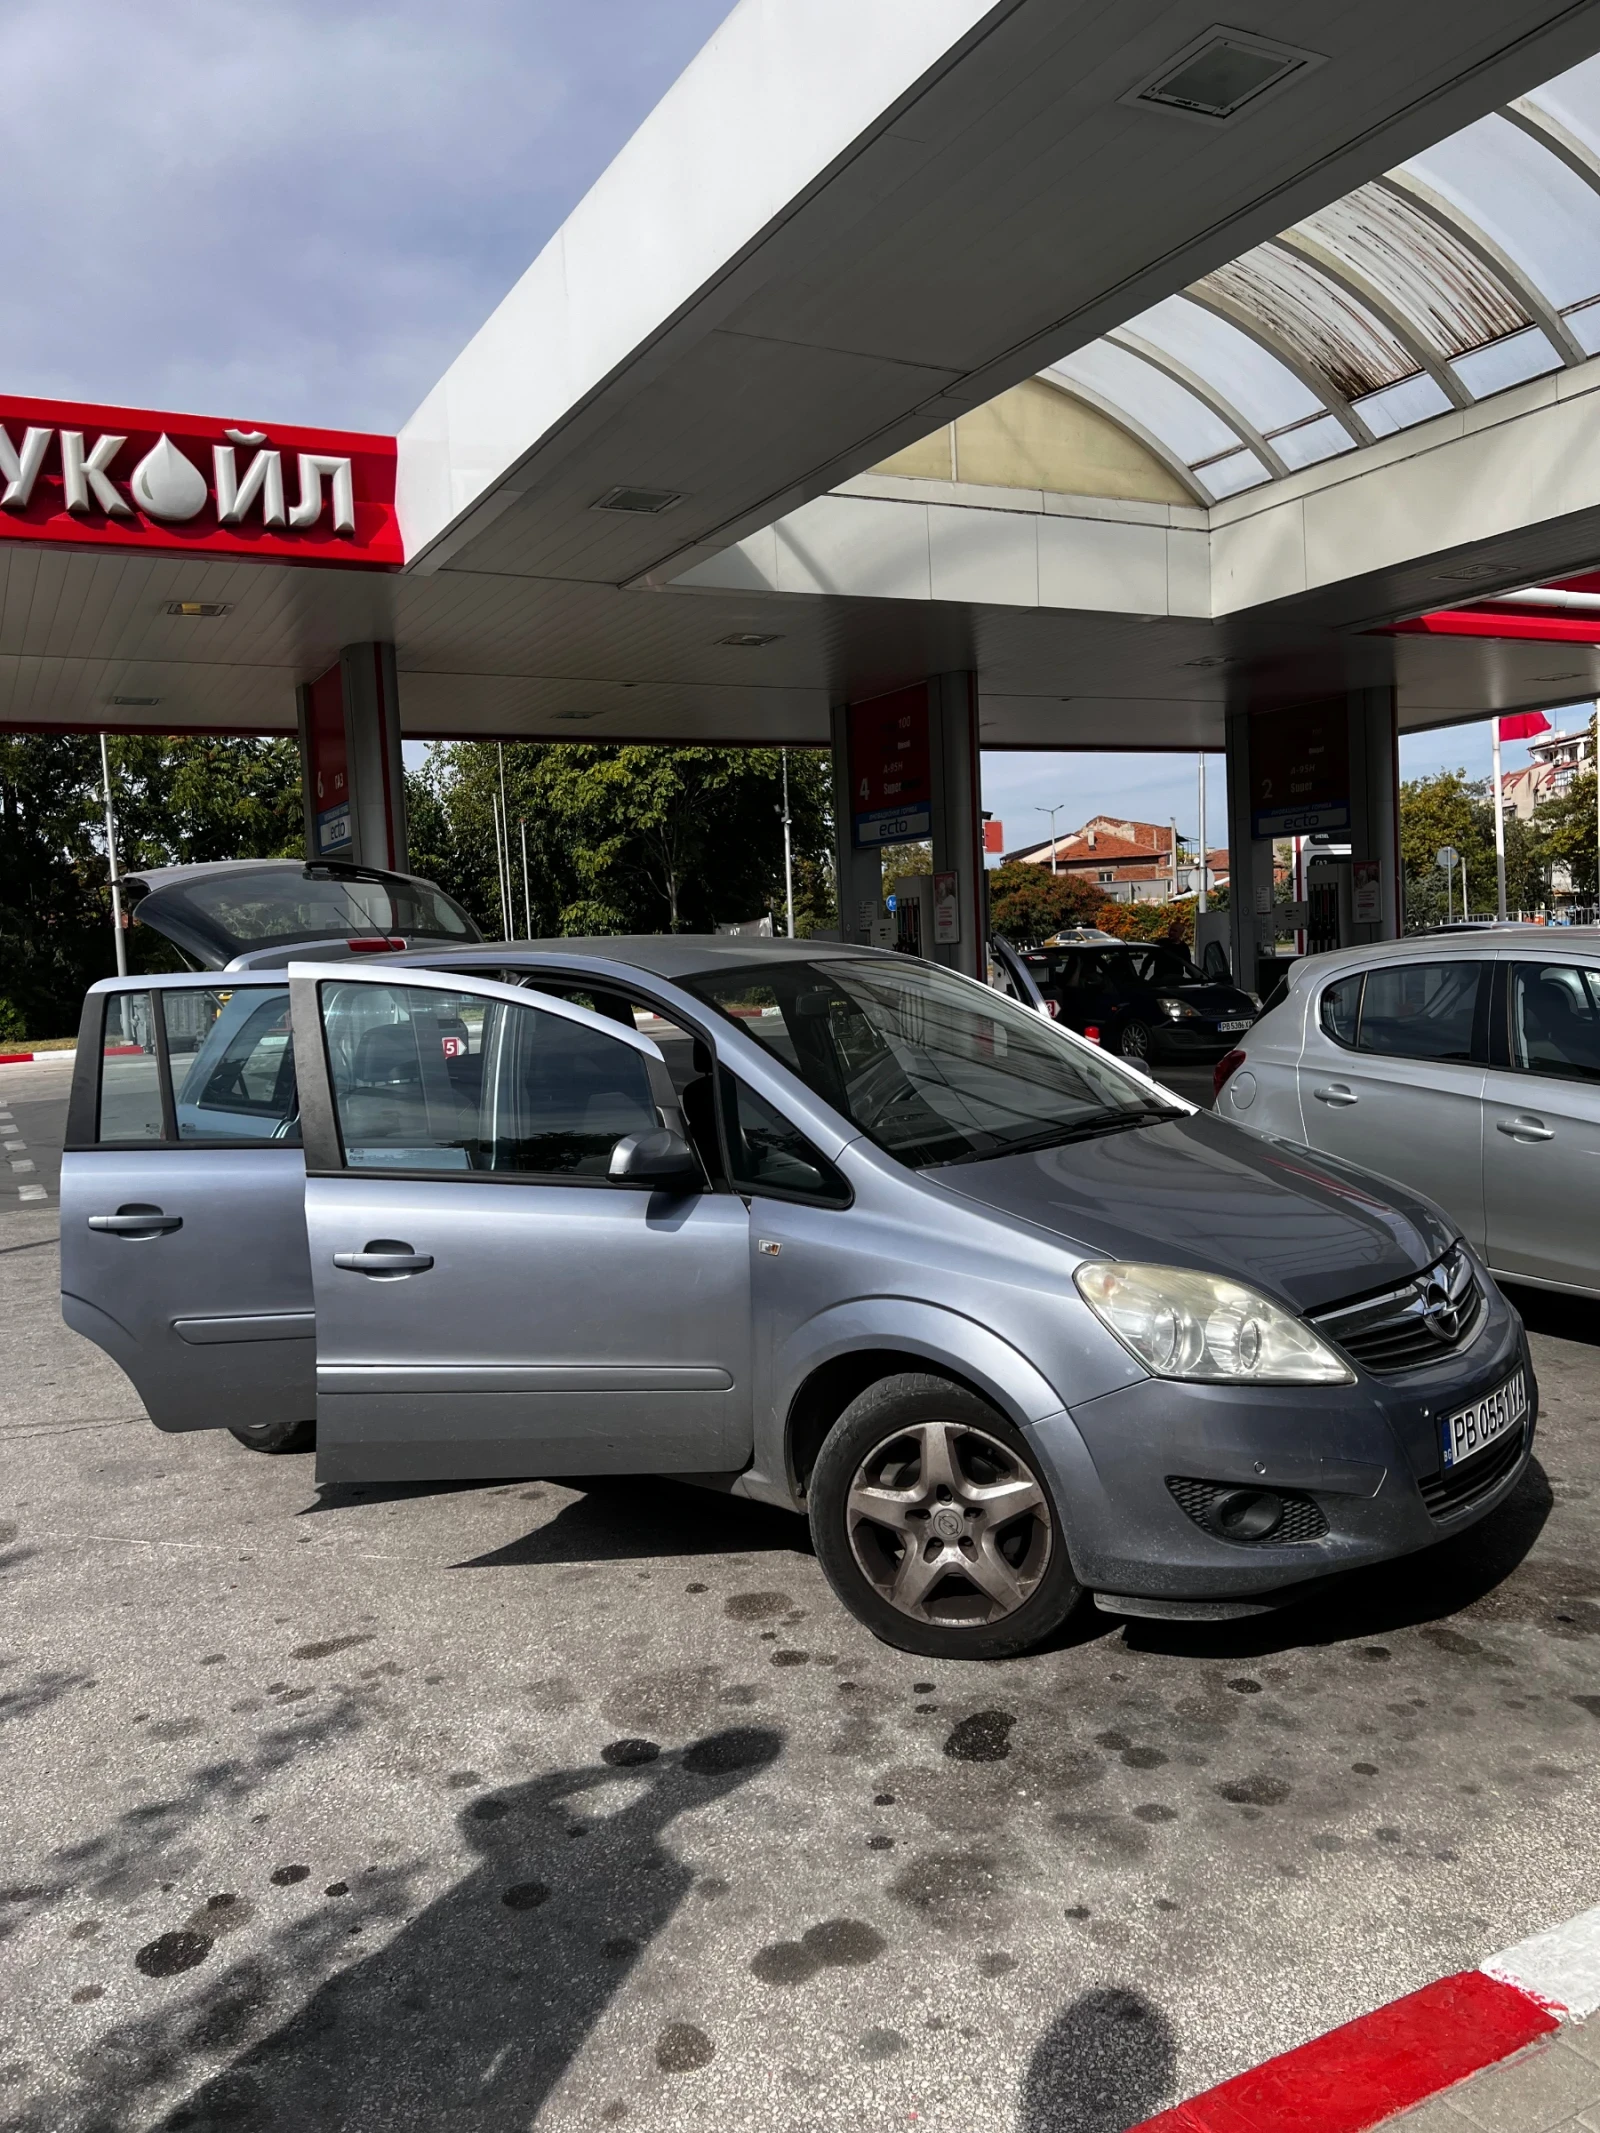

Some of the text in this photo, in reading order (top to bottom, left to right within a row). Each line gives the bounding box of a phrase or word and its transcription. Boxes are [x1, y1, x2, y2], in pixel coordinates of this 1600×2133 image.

[317, 772, 324, 798] 6
[335, 773, 344, 789] ГАЗ
[860, 777, 870, 800] 4
[883, 781, 902, 795] Super
[1262, 779, 1273, 799] 2
[1290, 781, 1313, 793] Super
[879, 818, 908, 836] ecto
[1283, 813, 1320, 830] ecto
[330, 820, 346, 841] ecto
[446, 1041, 455, 1055] 5
[1453, 1410, 1478, 1458] PB
[1443, 1448, 1452, 1463] BG
